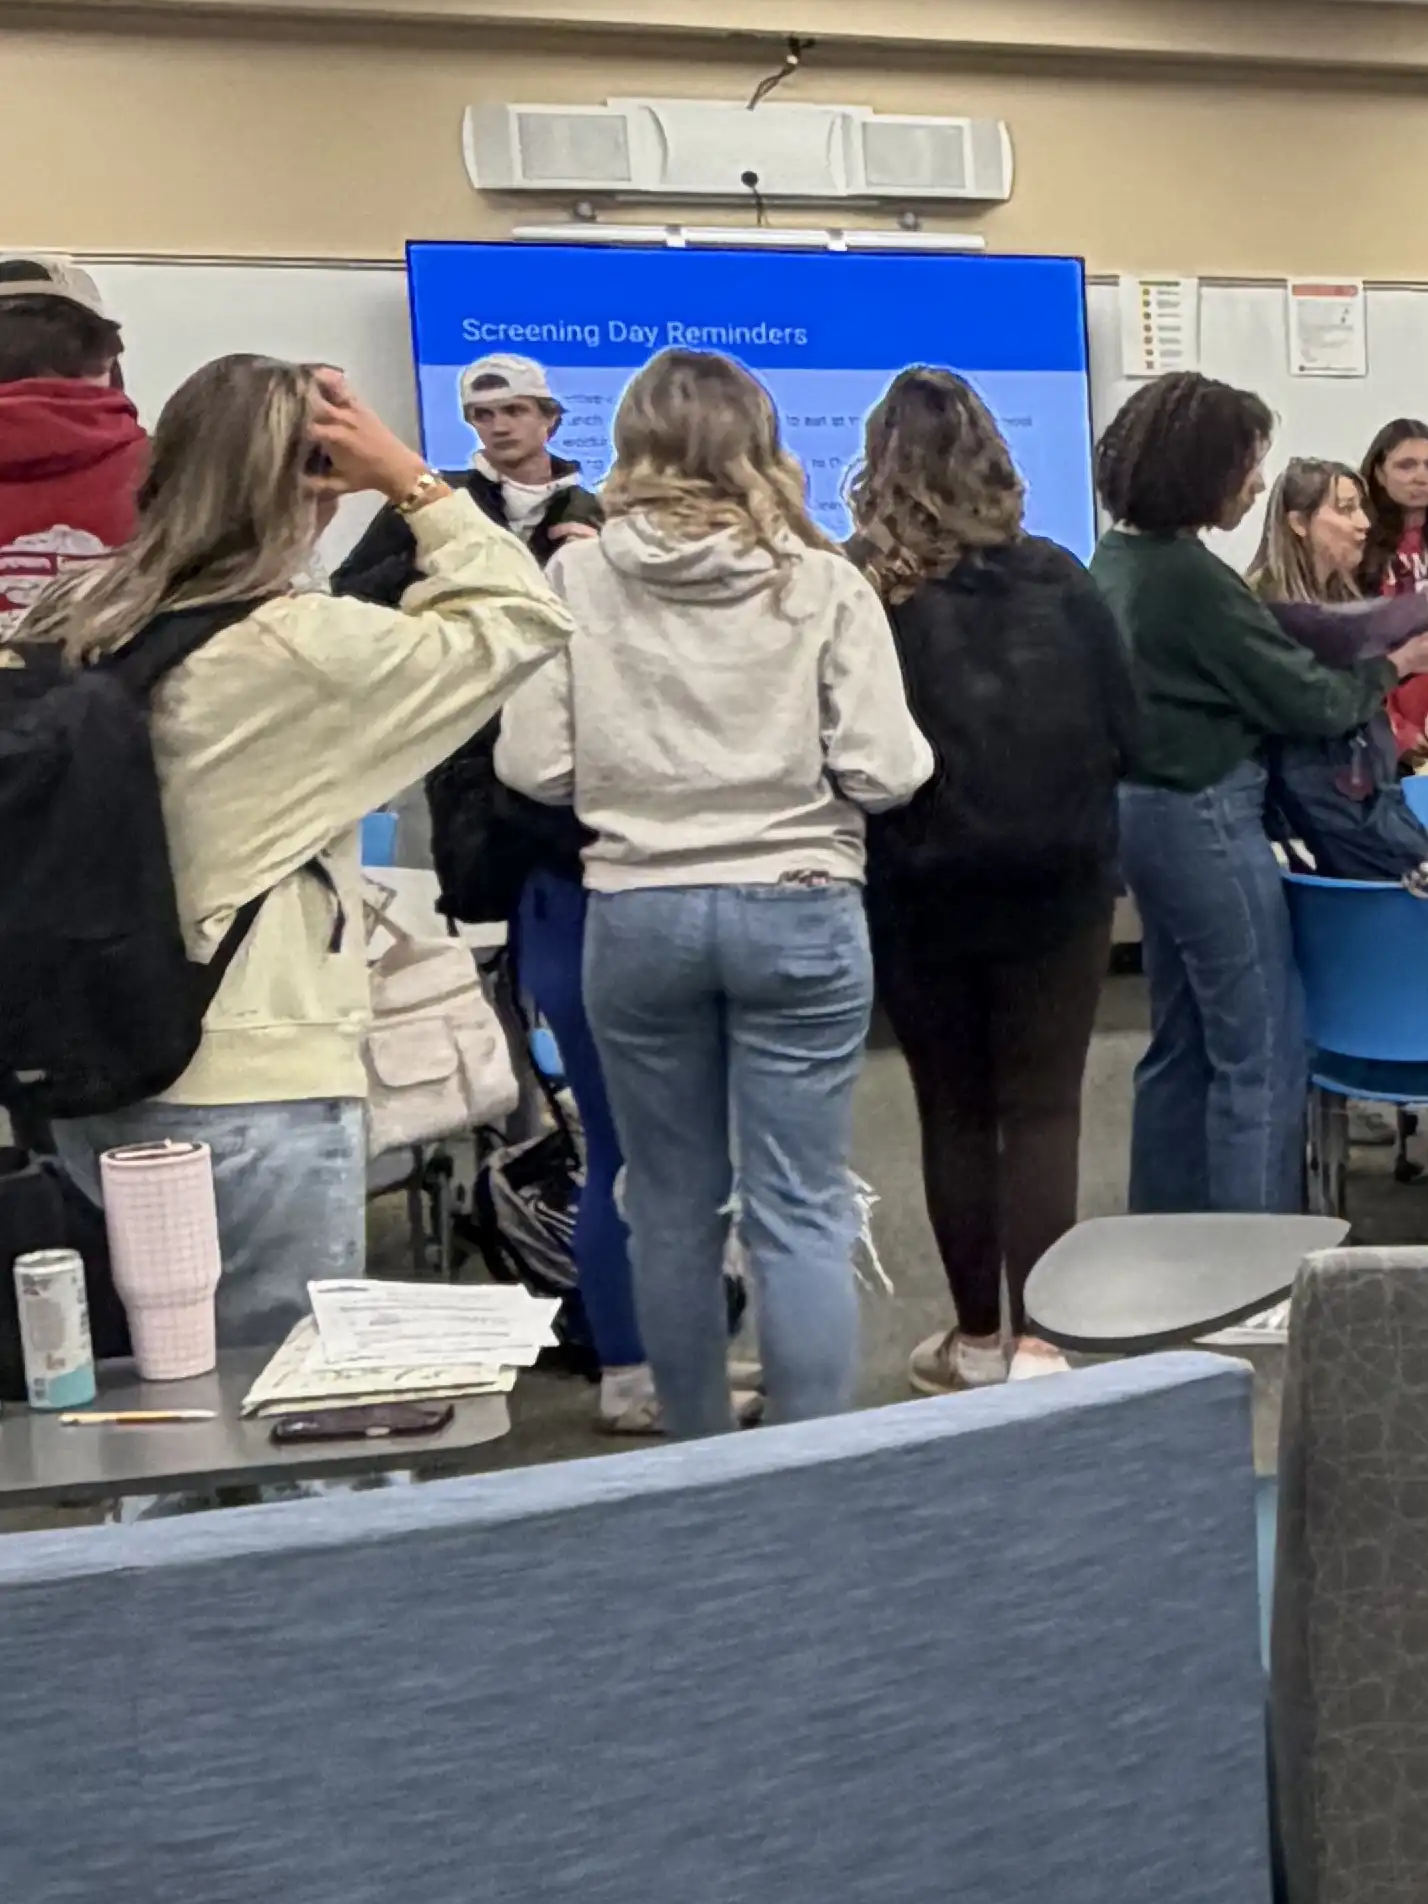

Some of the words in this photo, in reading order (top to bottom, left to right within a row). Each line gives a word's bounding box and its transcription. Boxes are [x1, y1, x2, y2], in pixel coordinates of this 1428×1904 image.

[462, 318, 600, 347] Screening
[608, 320, 659, 347] Day
[666, 320, 808, 346] Reminders
